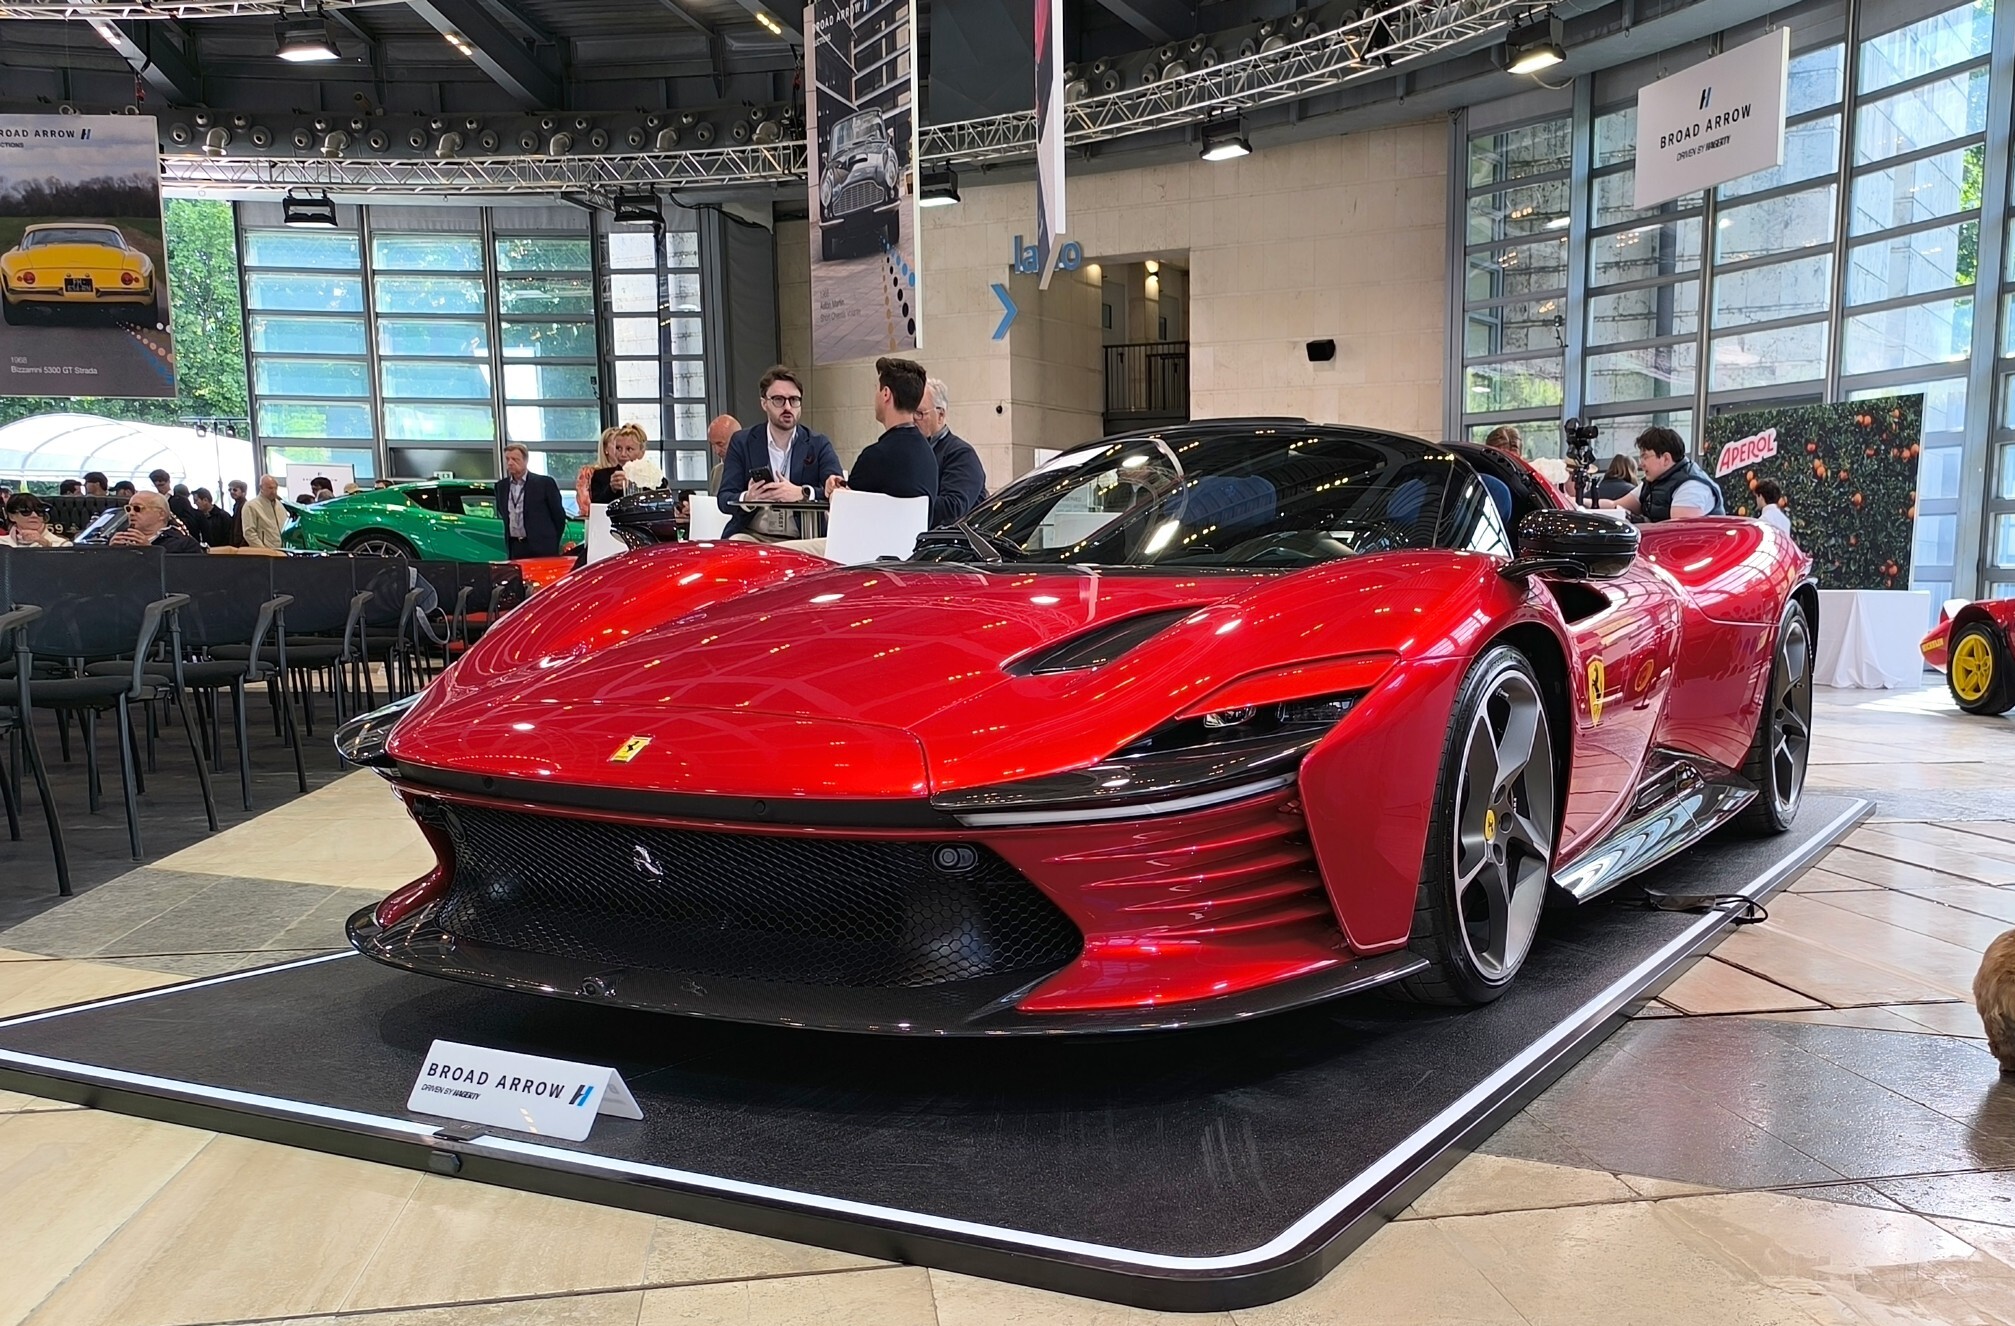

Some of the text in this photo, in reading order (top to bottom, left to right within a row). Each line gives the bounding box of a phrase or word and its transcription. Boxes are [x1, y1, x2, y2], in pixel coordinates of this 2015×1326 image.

[34, 129, 75, 138] ARROW
[1660, 103, 1751, 149] BROAD ARROW
[1676, 147, 1697, 162] DRIVEN
[43, 366, 61, 374] 5300
[62, 366, 73, 374] GT
[74, 367, 98, 375] Strada
[1719, 433, 1774, 472] APEROL
[427, 1062, 489, 1085] BROAD
[495, 1075, 565, 1099] ARROW
[421, 1083, 482, 1101] DRIVEN BY HAGERTY
